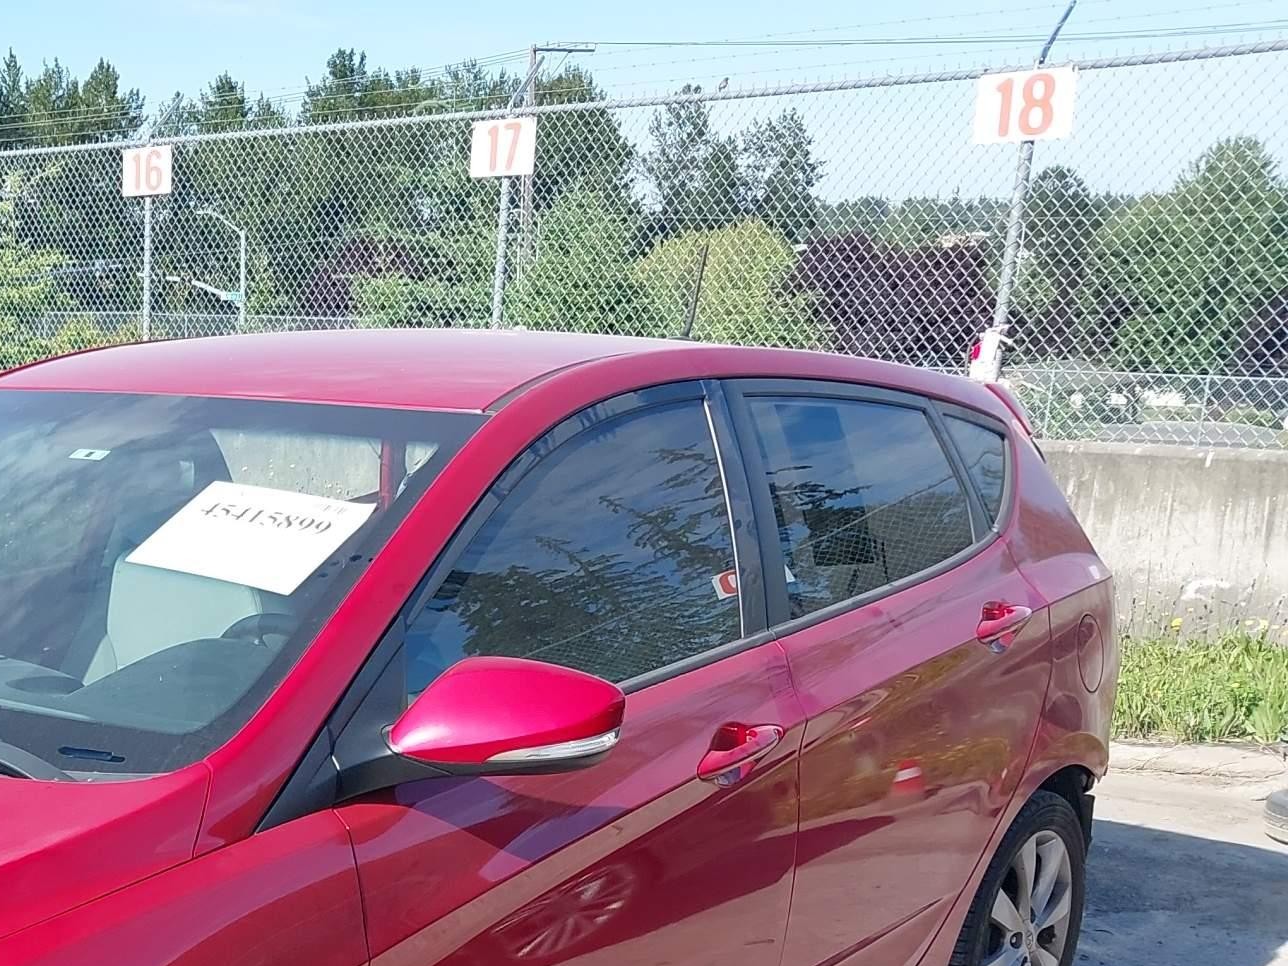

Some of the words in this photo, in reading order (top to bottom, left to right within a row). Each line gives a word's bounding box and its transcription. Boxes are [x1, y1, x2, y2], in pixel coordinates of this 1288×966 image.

[996, 73, 1056, 137] 18
[132, 148, 162, 191] 16
[488, 122, 521, 171] 17
[200, 502, 333, 535] 45415899
